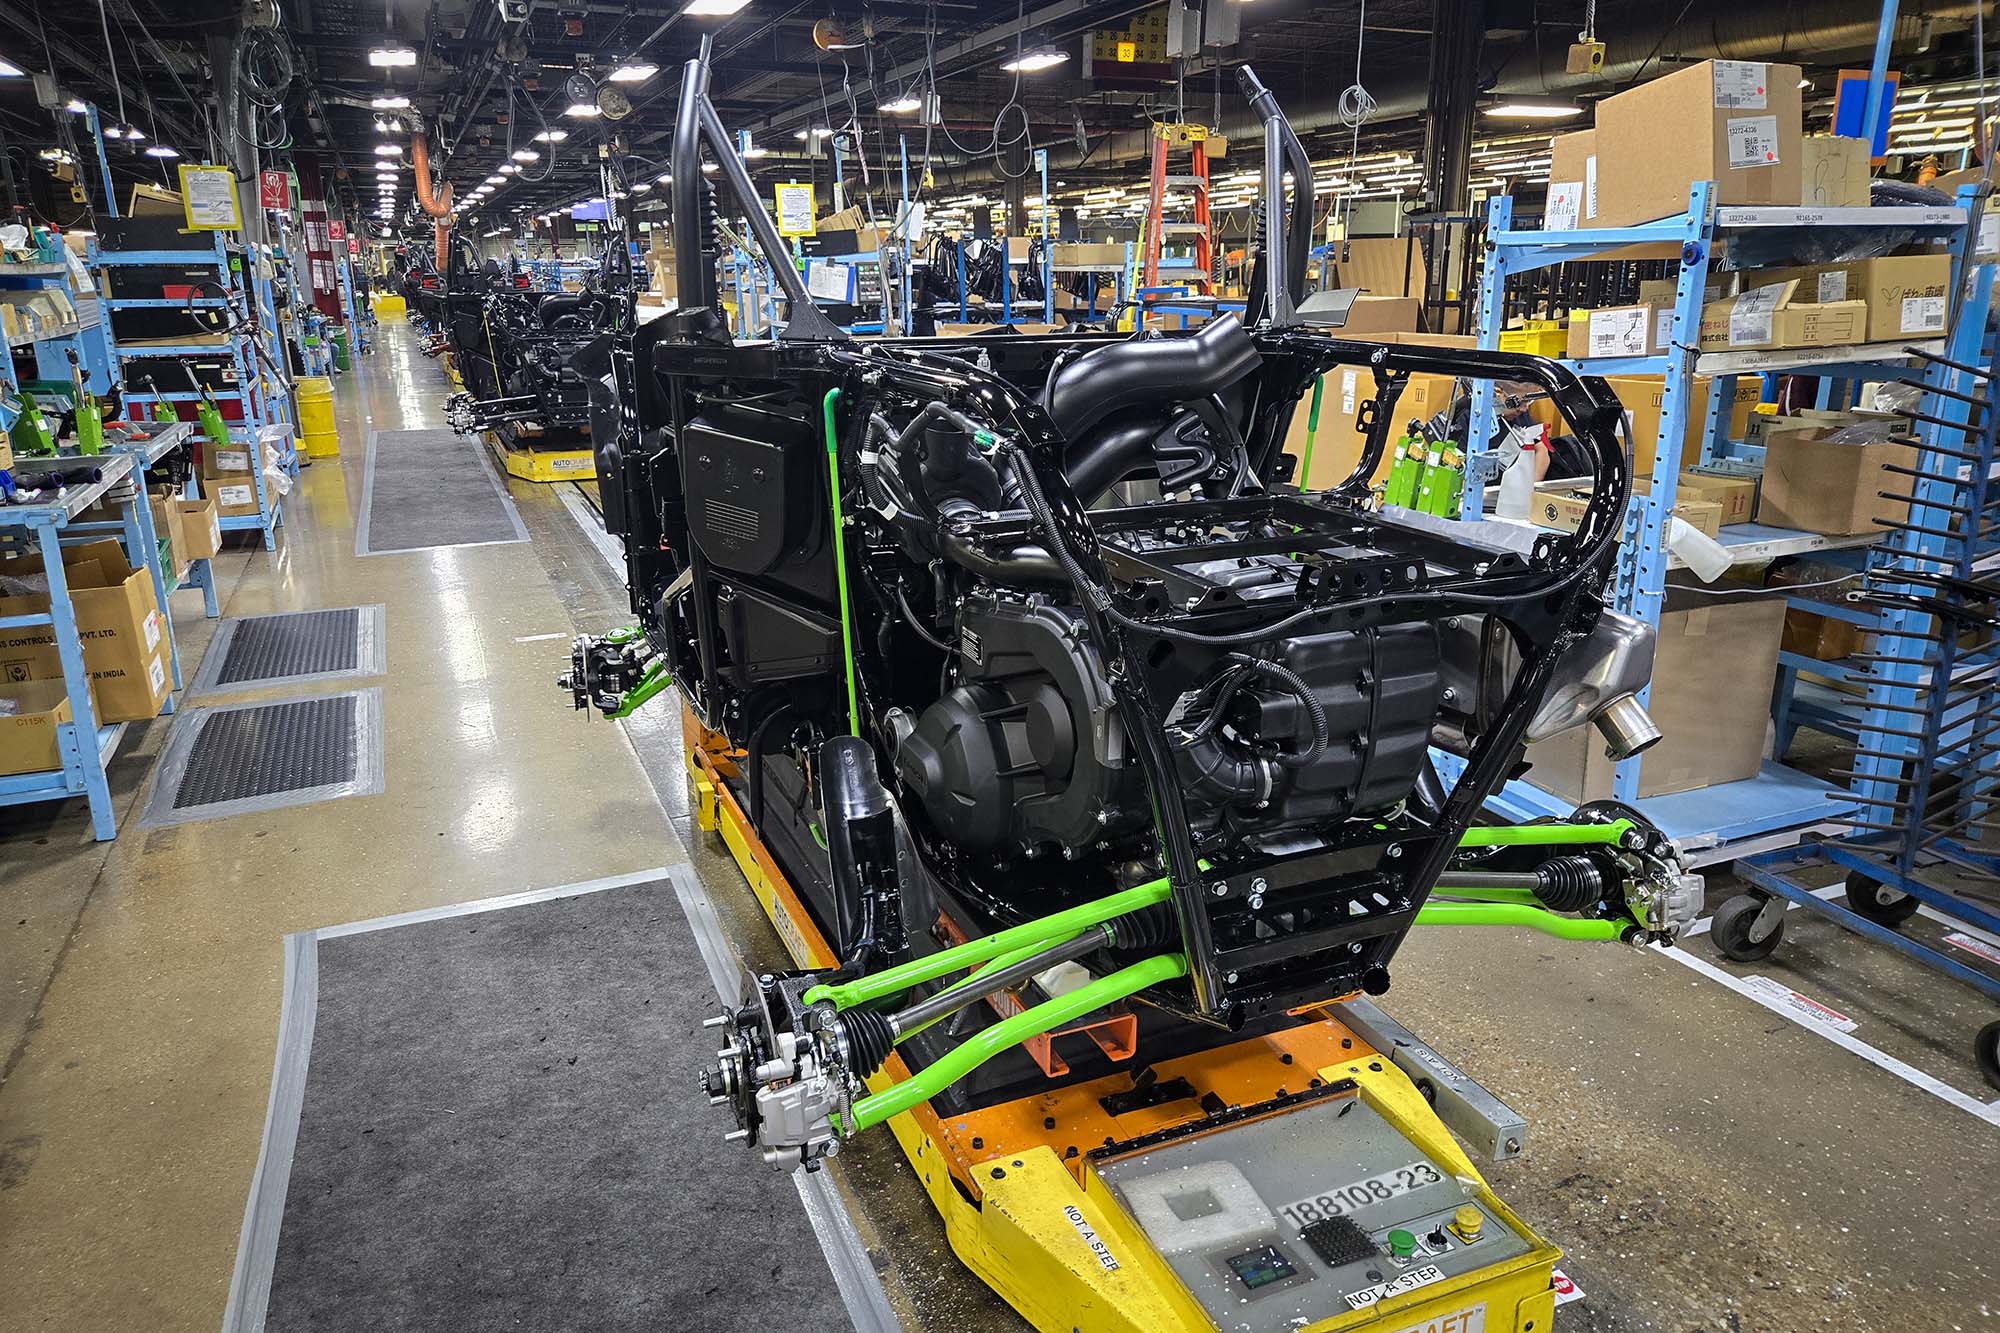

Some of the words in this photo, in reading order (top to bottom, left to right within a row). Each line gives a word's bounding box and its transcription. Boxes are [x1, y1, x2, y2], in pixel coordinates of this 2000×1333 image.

[1123, 49, 1130, 58] 33
[1136, 49, 1144, 58] 34
[9, 636, 54, 647] CONTROLS
[80, 631, 98, 641] PVT.
[99, 628, 117, 638] LTD.
[92, 672, 102, 680] IN
[103, 669, 126, 678] INDIA
[15, 717, 48, 728] C115K
[1283, 1164, 1441, 1226] 188108-23
[1064, 1205, 1088, 1226] NOT
[1082, 1231, 1096, 1240] A
[1091, 1241, 1120, 1272] STEP
[1347, 1287, 1380, 1307] NOT
[1387, 1282, 1400, 1293] A
[1400, 1266, 1438, 1288] STEP
